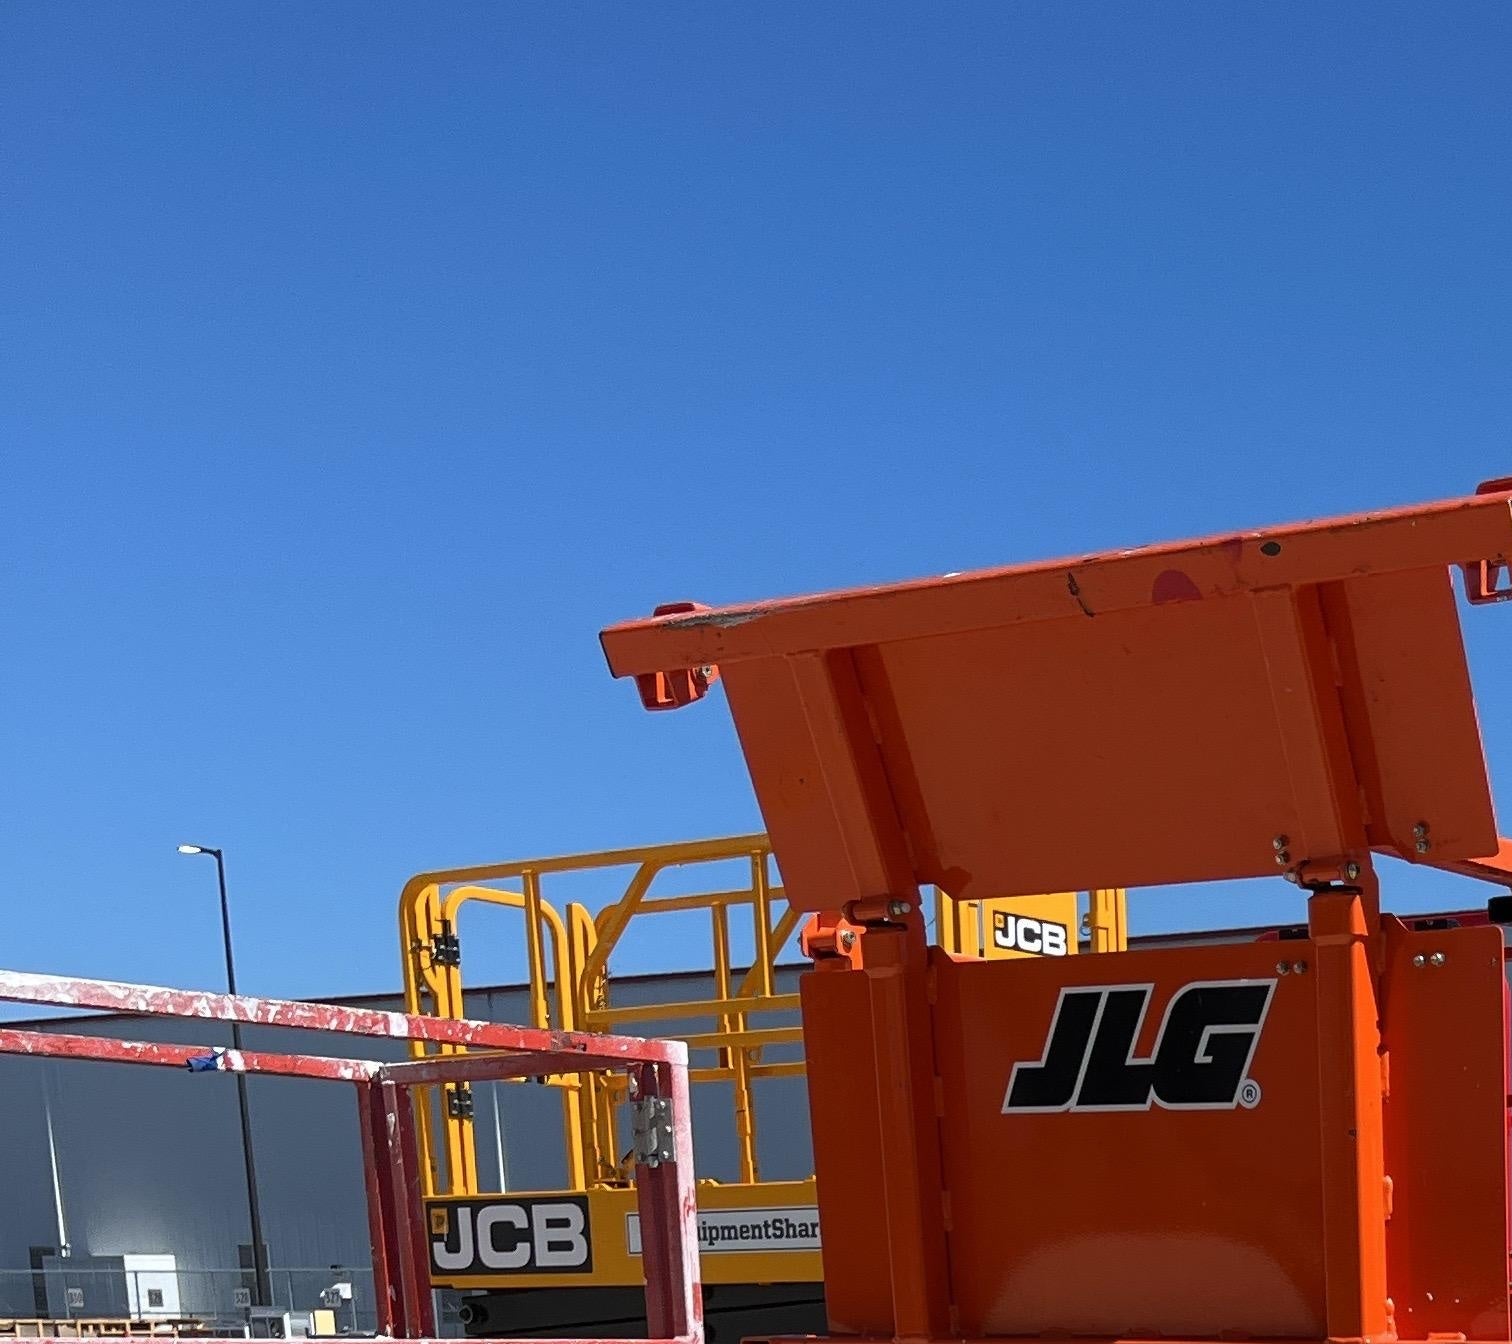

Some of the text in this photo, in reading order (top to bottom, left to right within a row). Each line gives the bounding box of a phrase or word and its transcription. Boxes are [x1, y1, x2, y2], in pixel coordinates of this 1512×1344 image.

[995, 917, 1067, 957] JCB
[1003, 979, 1276, 1112] JLG
[433, 1203, 588, 1270] JCB
